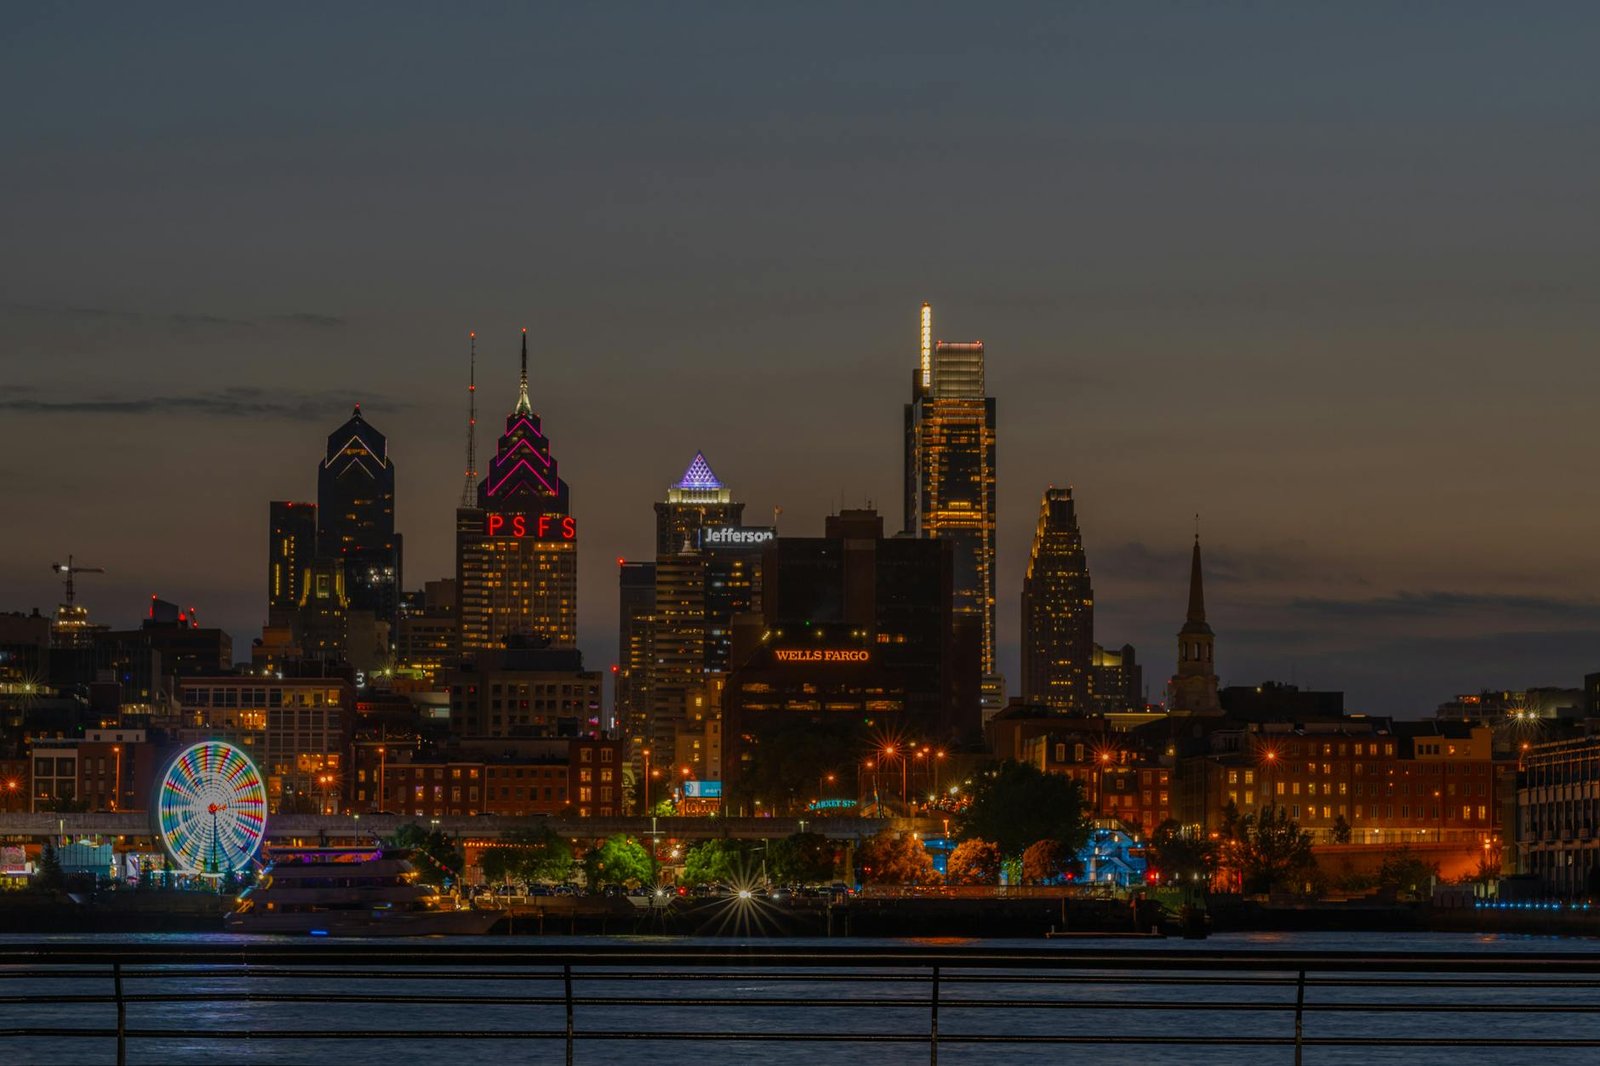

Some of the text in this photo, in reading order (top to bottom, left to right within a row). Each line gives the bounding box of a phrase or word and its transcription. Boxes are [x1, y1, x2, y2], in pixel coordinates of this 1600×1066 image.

[705, 528, 774, 543] Jefferson
[775, 650, 869, 661] WELLS FARGO
